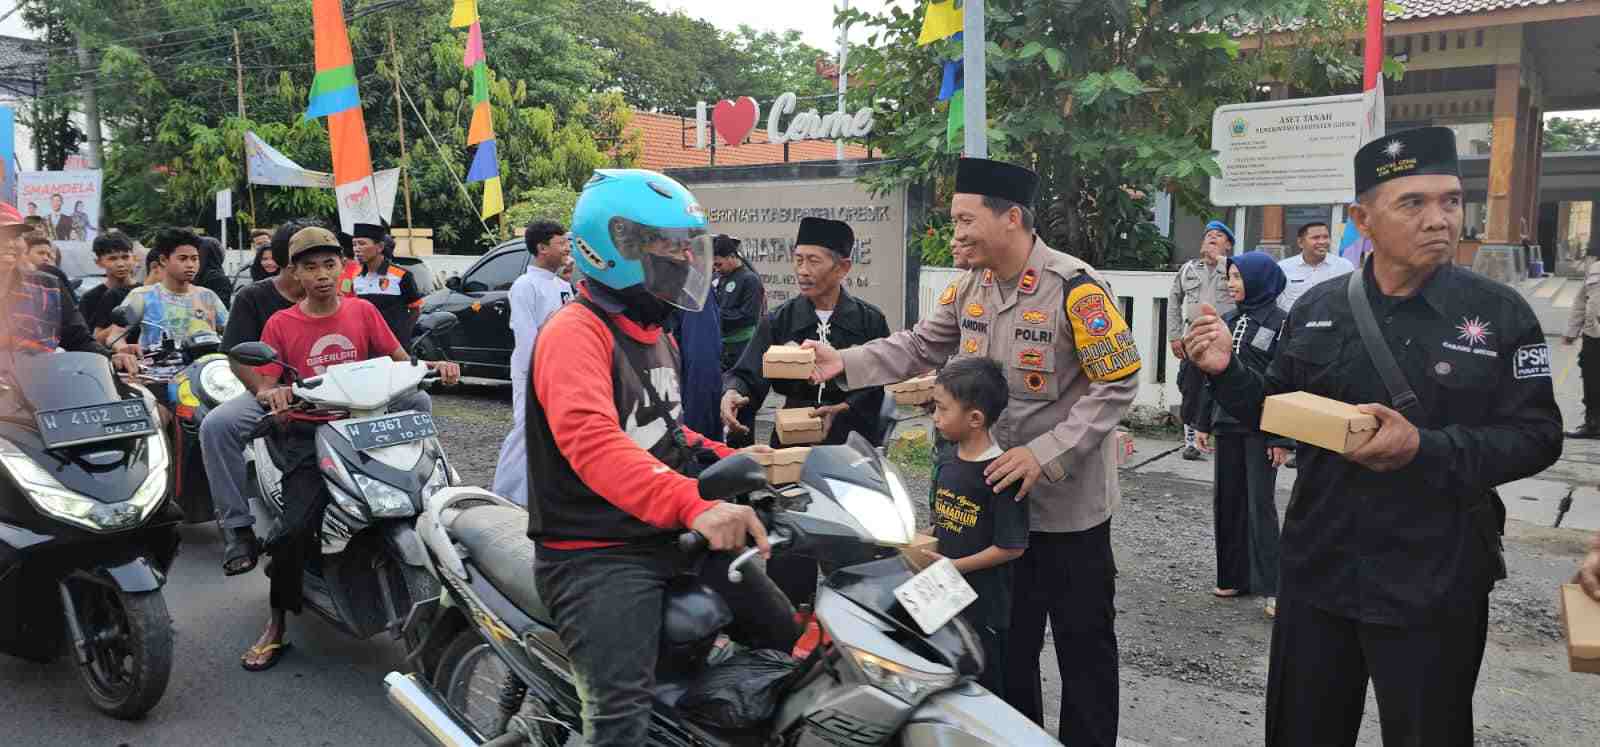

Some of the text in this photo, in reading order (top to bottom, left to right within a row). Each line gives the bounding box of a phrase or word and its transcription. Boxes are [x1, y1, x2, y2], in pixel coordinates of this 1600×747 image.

[1303, 112, 1333, 122] TANAH
[23, 182, 96, 194] SMAMDELA
[1015, 328, 1052, 343] POLRI
[71, 408, 111, 425] 4102
[123, 404, 142, 418] EP
[347, 424, 360, 437] W
[368, 418, 402, 434] 2967
